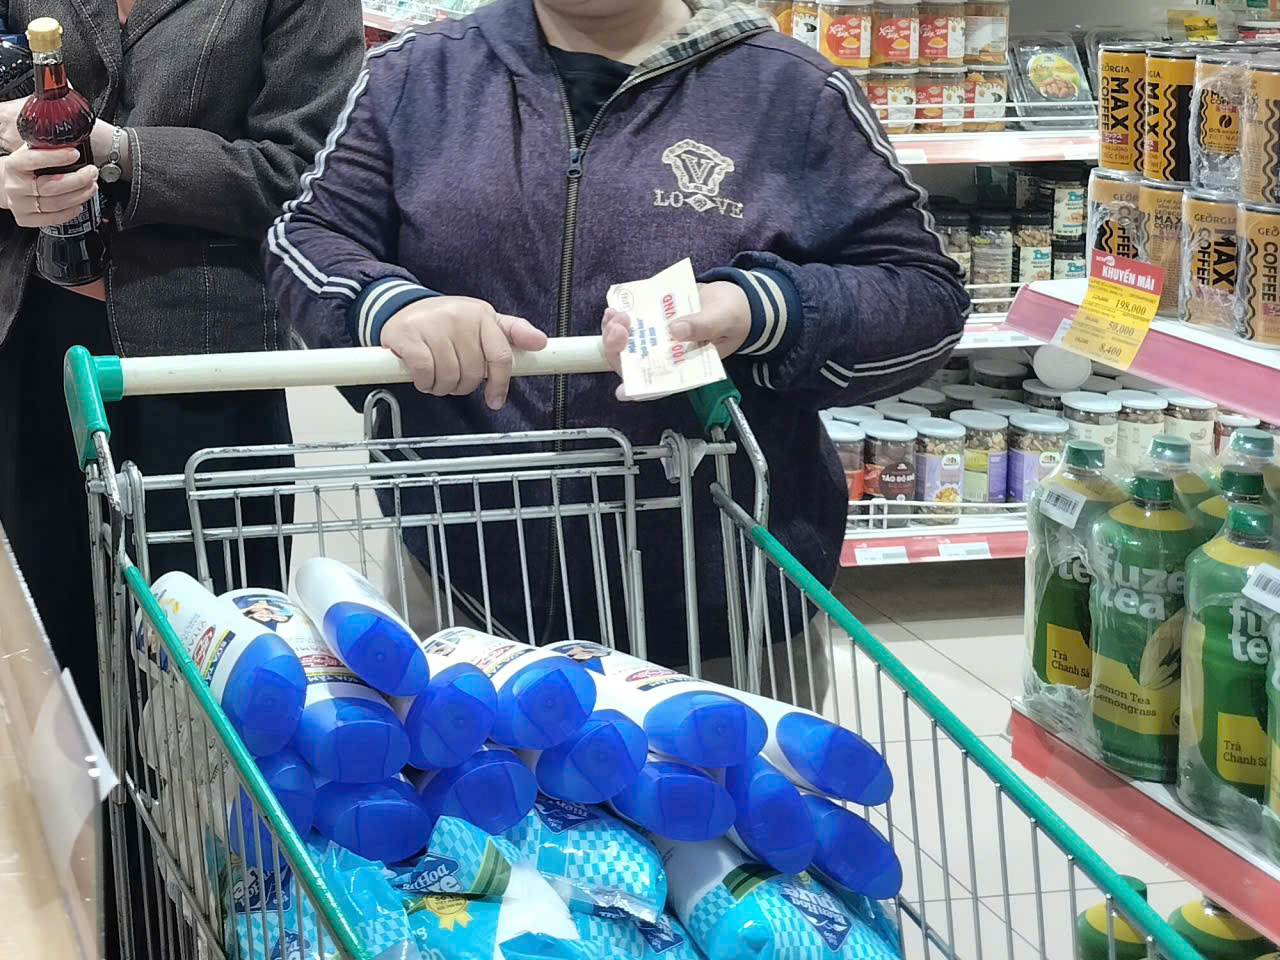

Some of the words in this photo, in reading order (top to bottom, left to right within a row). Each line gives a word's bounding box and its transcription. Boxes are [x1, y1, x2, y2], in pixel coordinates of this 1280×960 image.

[1101, 76, 1110, 131] COFFEE
[1110, 77, 1129, 131] MAX
[1154, 215, 1183, 225] MAX
[1154, 222, 1182, 231] COFFE
[1197, 227, 1211, 287] COFFEE
[1212, 228, 1236, 287] MAX
[1261, 241, 1278, 302] COFFEE
[1228, 629, 1269, 665] te
[1051, 660, 1079, 677] Chanh
[1094, 690, 1157, 718] Lemongrass
[1130, 692, 1151, 705] Tea
[1223, 752, 1257, 767] Chanh
